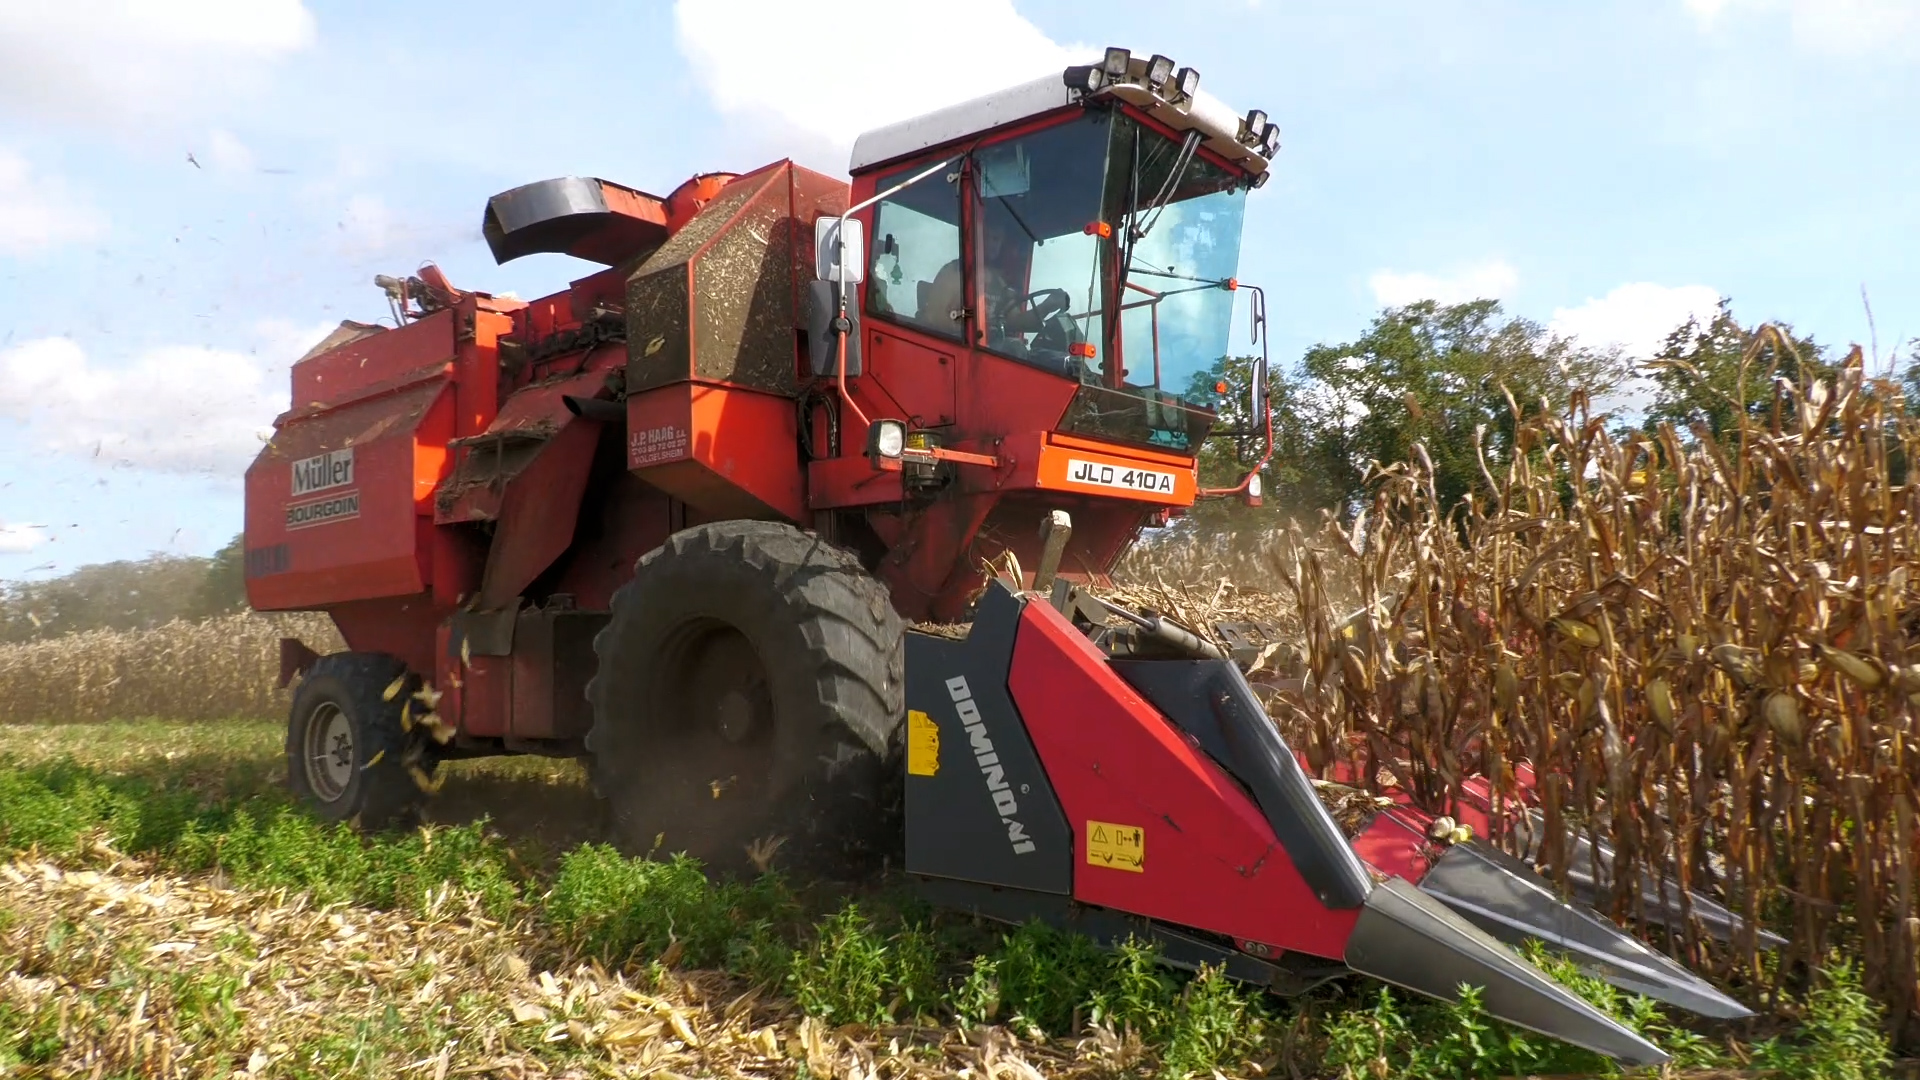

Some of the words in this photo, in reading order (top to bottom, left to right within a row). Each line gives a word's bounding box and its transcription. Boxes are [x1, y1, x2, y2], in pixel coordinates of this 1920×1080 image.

[648, 426, 674, 444] HAAG
[634, 448, 684, 464] VOLGELSHEIM
[293, 453, 352, 496] Müller
[1074, 463, 1115, 485] JLD
[285, 495, 359, 524] BOURGOIN
